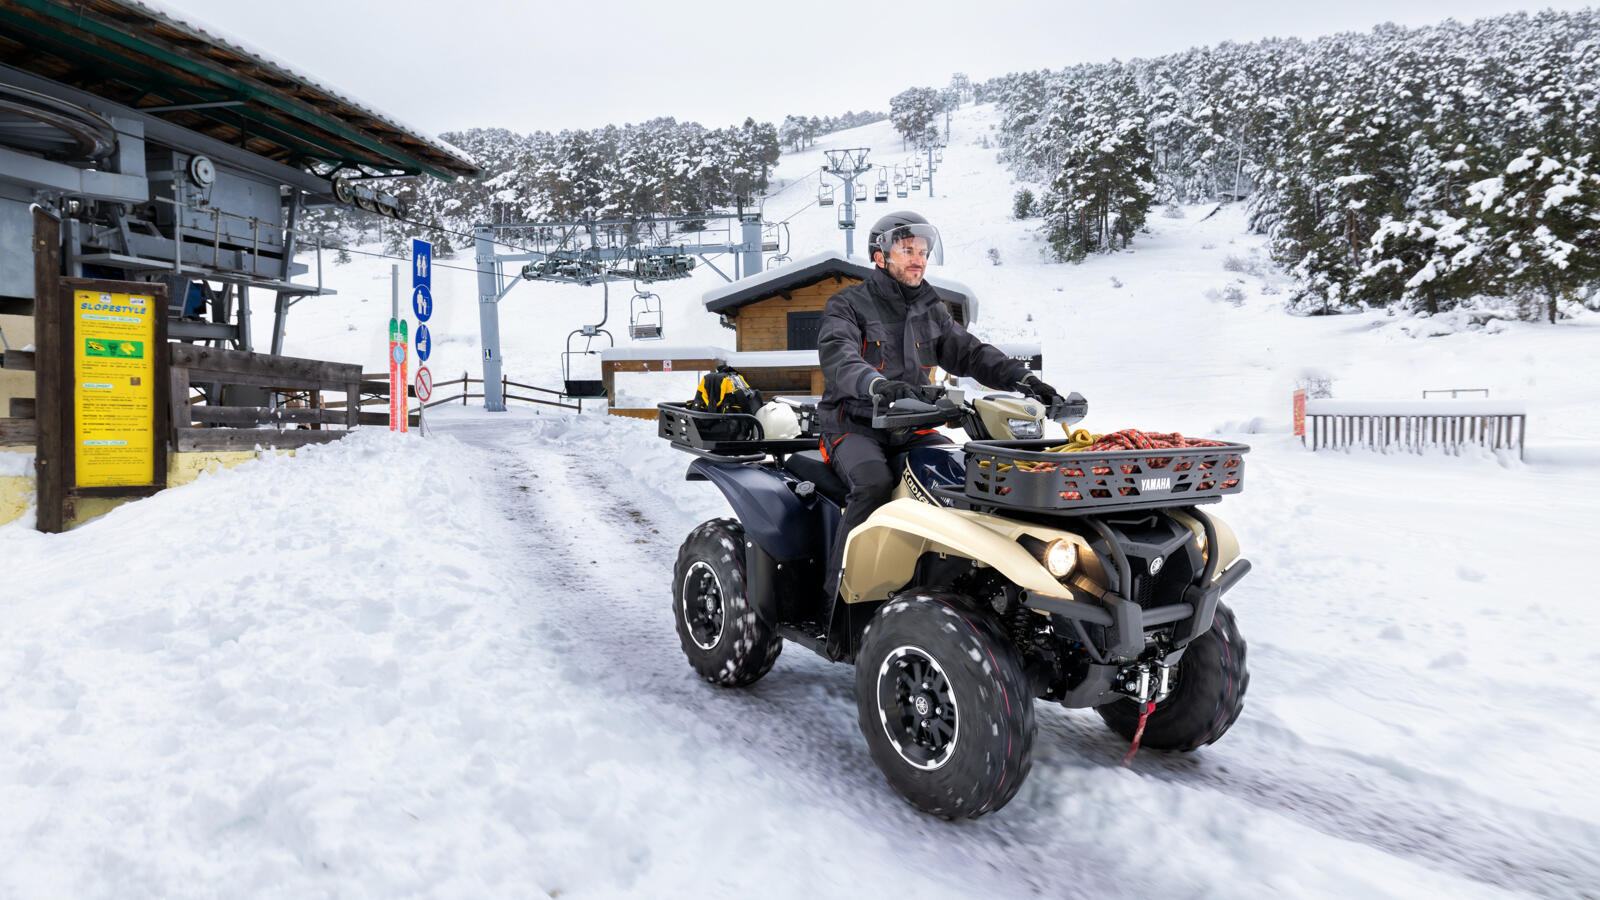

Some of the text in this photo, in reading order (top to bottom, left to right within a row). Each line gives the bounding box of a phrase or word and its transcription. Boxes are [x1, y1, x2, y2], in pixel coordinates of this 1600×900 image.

[80, 303, 147, 314] SLOPESTYLE
[903, 468, 929, 503] KODIA
[1141, 477, 1171, 491] YAMAHA
